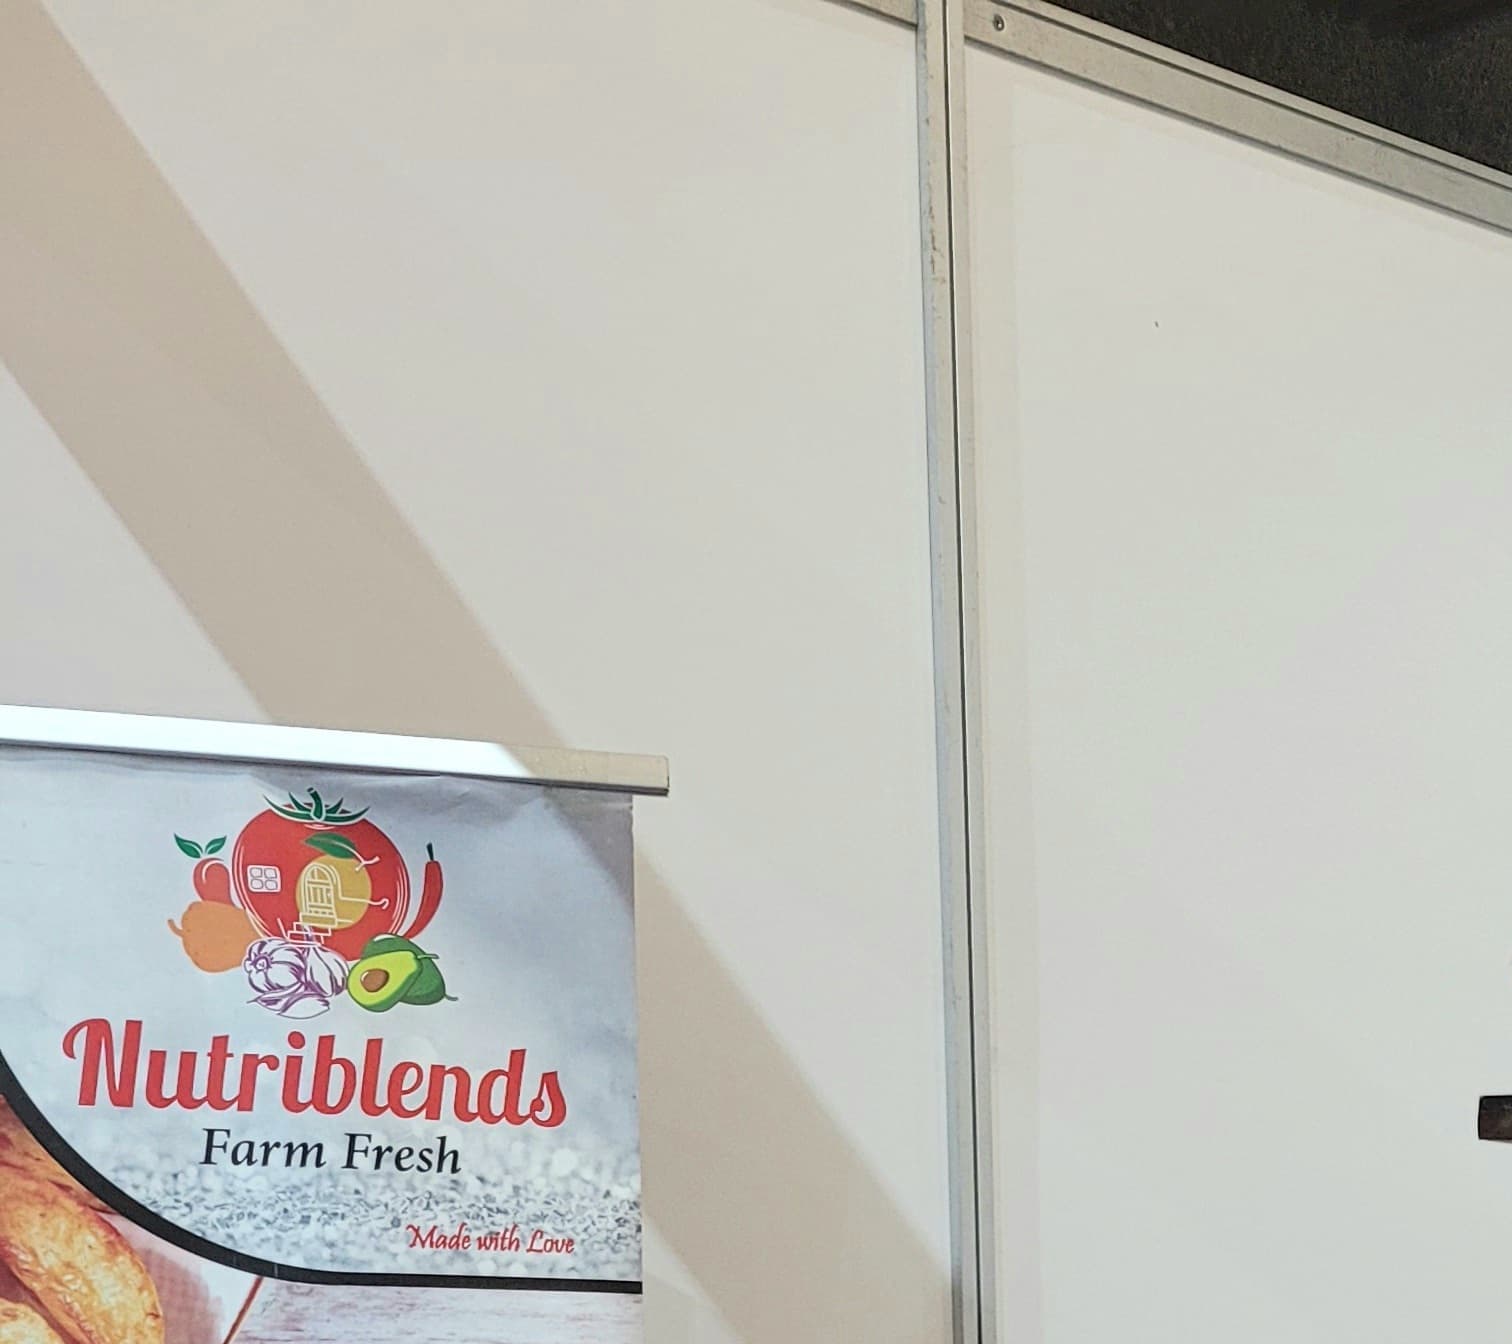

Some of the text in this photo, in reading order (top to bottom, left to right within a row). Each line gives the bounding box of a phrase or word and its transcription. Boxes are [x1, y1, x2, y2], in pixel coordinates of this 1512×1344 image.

[62, 1017, 567, 1128] Nutriblends
[200, 1128, 462, 1175] Farm Fresh
[406, 1223, 576, 1256] Made with Love
